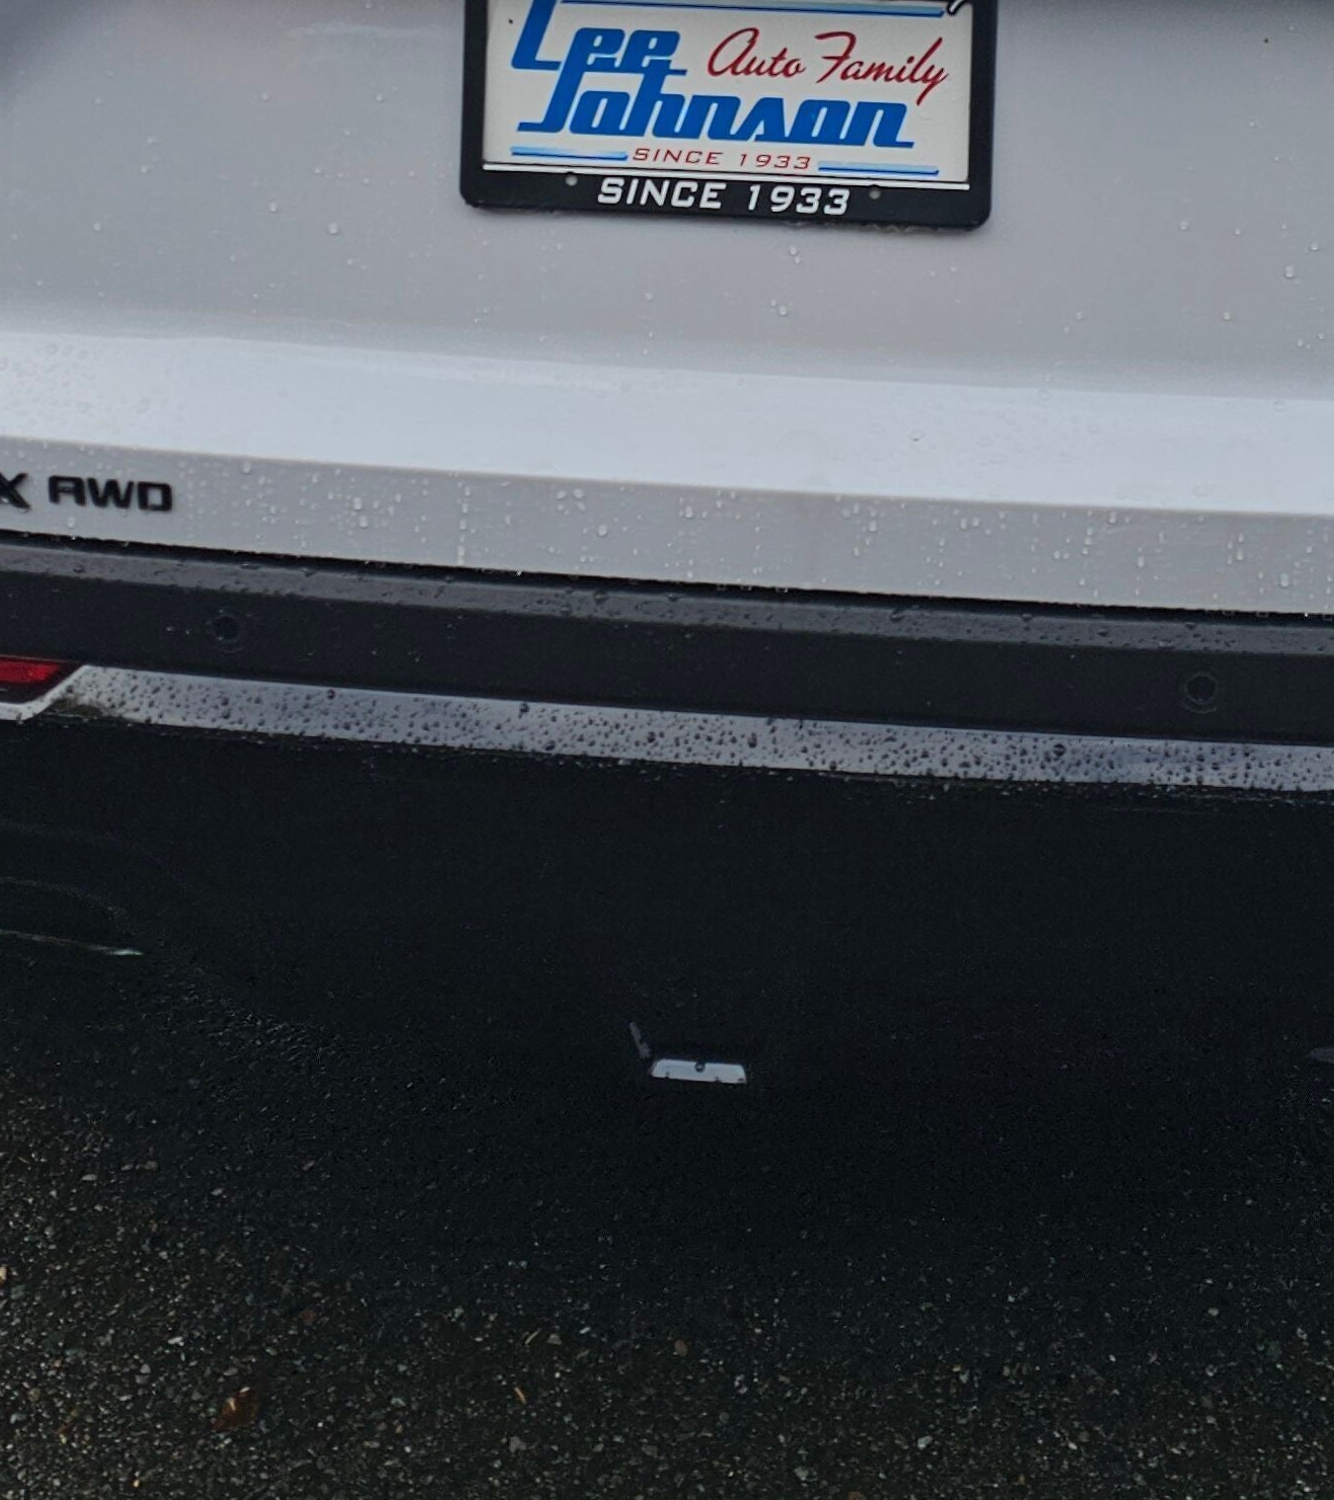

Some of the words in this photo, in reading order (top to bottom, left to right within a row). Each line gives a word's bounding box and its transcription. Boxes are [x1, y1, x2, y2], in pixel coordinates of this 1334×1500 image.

[707, 27, 806, 78] Auto
[814, 31, 949, 106] Family
[517, 60, 915, 149] Johnson
[632, 147, 723, 165] SINCE
[740, 153, 811, 170] 1933
[597, 177, 727, 209] SINCE
[748, 184, 850, 216] 1933
[48, 474, 174, 513] AWD
